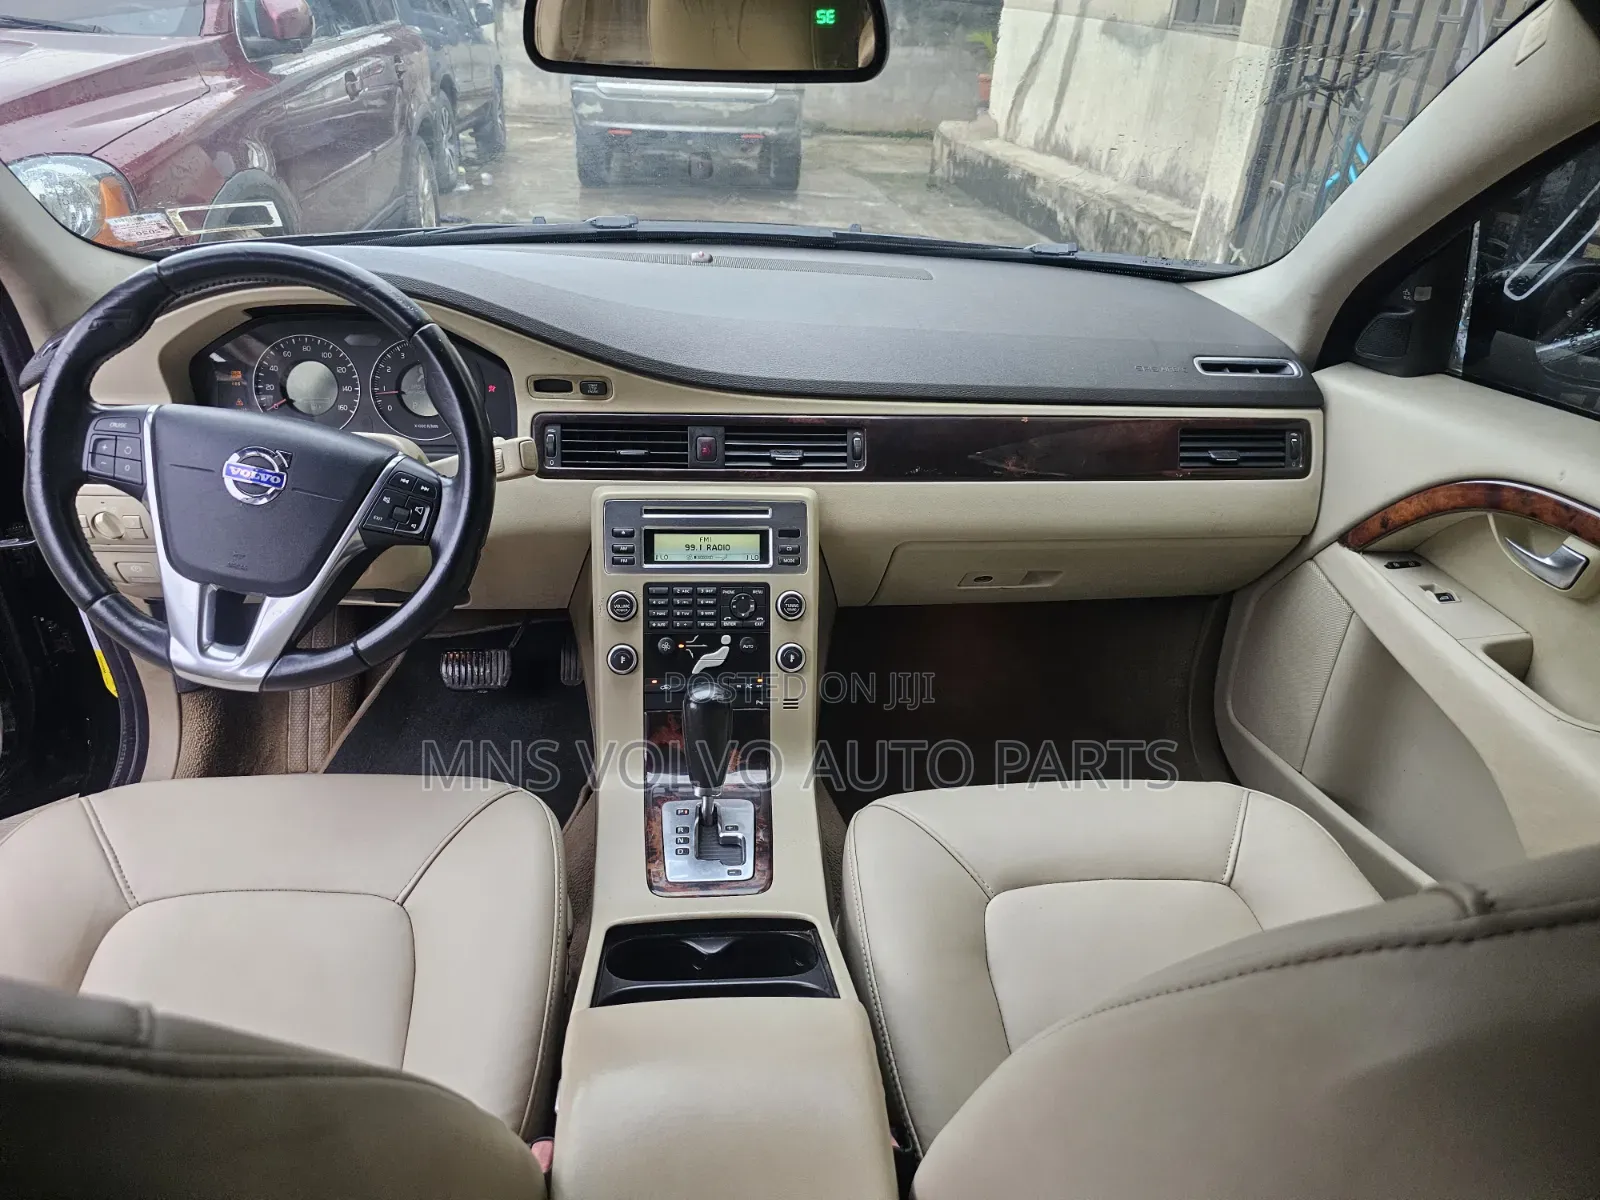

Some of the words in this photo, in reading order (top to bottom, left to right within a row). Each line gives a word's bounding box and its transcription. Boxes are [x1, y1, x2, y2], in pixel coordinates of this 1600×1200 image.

[815, 8, 836, 25] SE
[282, 350, 292, 358] 60
[321, 351, 333, 359] 100
[400, 352, 406, 360] 3
[269, 364, 279, 372] 40
[336, 366, 347, 374] 120
[386, 365, 392, 373] 2
[265, 383, 275, 391] 20
[342, 384, 353, 392] 140
[337, 404, 349, 412] 160
[228, 465, 282, 484] VOLVO
[684, 543, 703, 552] 99.1
[706, 543, 731, 552] RADIO
